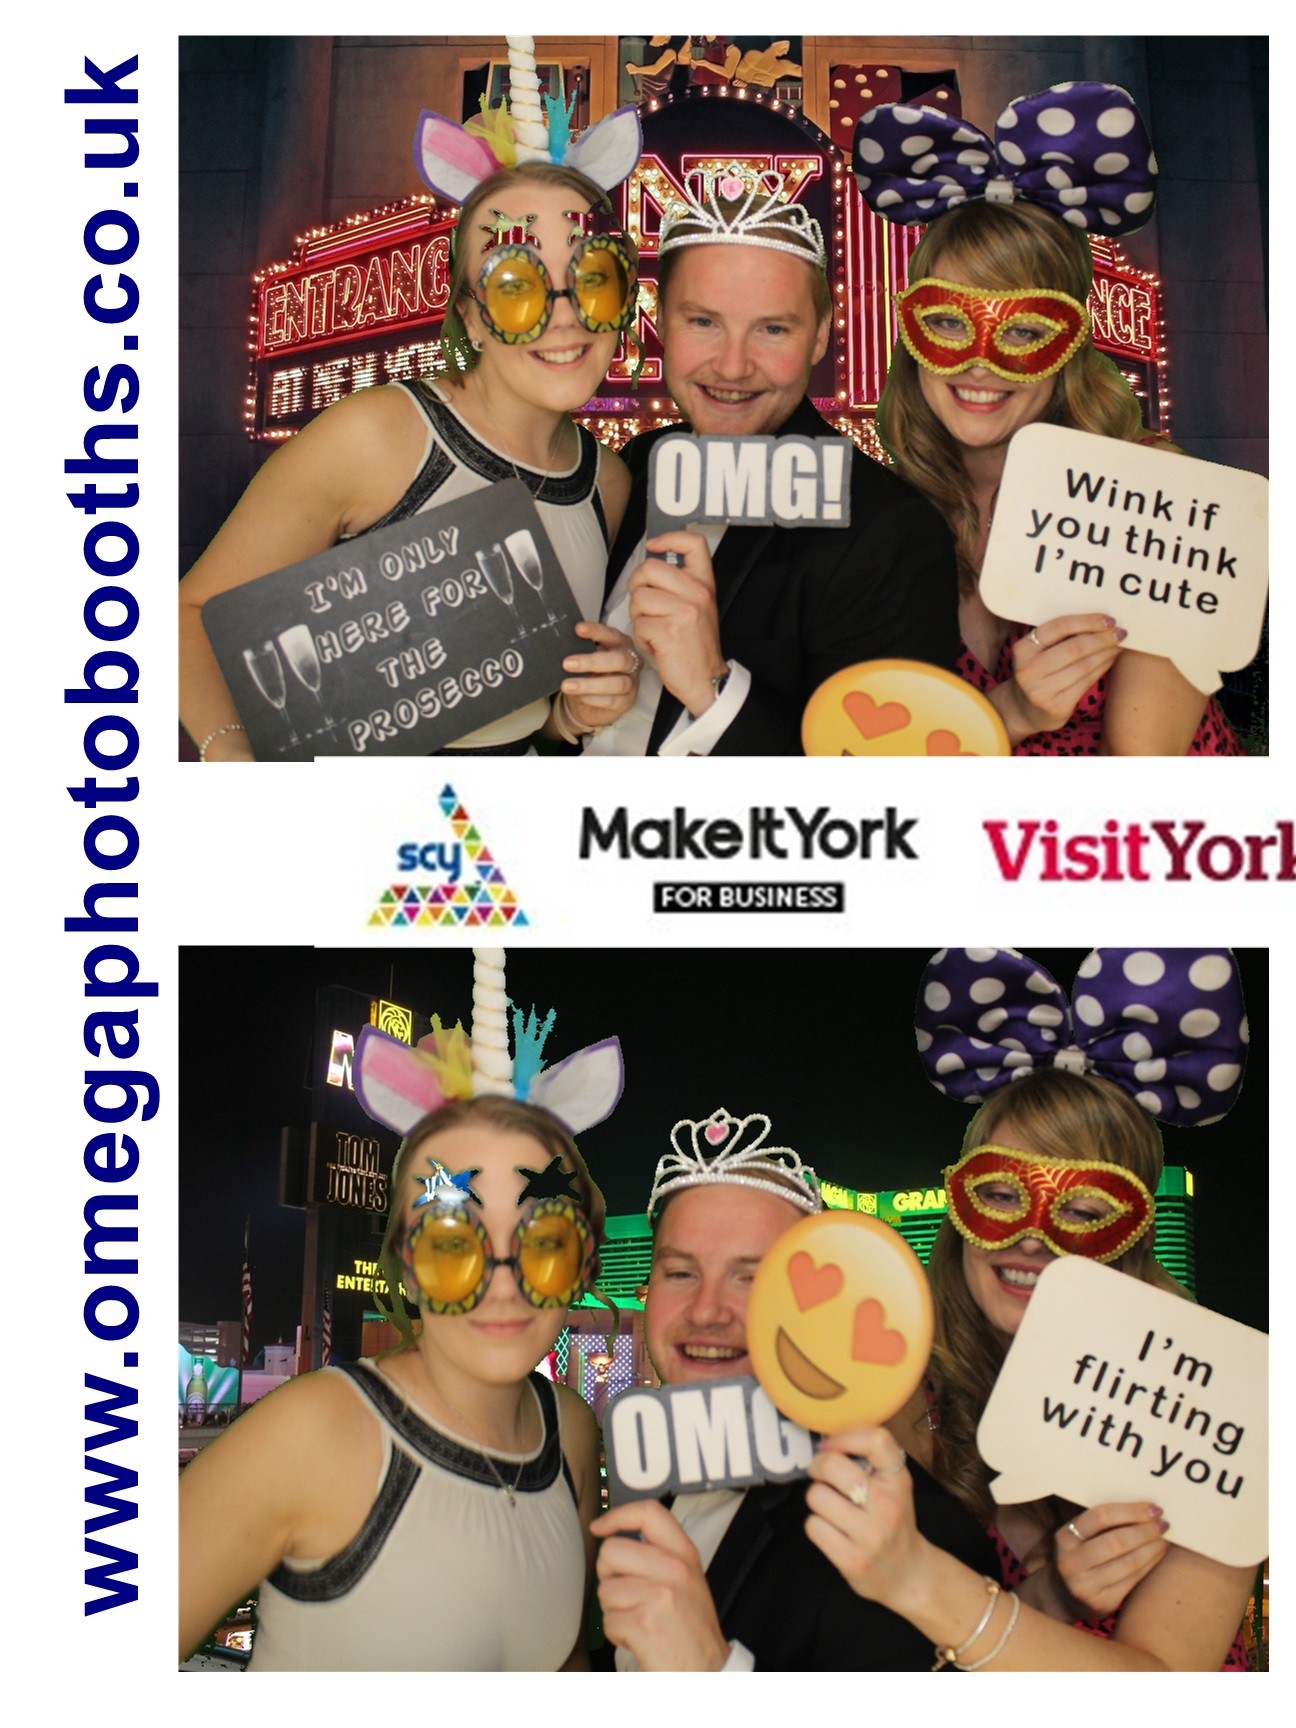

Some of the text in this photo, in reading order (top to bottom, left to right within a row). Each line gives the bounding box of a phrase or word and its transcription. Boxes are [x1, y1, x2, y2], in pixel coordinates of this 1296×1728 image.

[264, 236, 450, 346] ENTRANC
[655, 439, 844, 520] OMG!
[1067, 468, 1221, 531] Wink if
[304, 526, 459, 613] I'M ONLY
[1025, 509, 1238, 579] you think
[1035, 544, 1219, 614] I'm cute
[315, 568, 488, 663] HERE FOR
[376, 637, 447, 687] THE
[347, 648, 524, 752] PROSECCO
[336, 1131, 381, 1173] TOM
[326, 1167, 388, 1213] JONES
[892, 1188, 948, 1212] GRAN
[1138, 1329, 1213, 1387] I'm
[611, 1384, 814, 1490] OMG
[1073, 1354, 1245, 1456] flirting
[1043, 1396, 1244, 1499] with you
